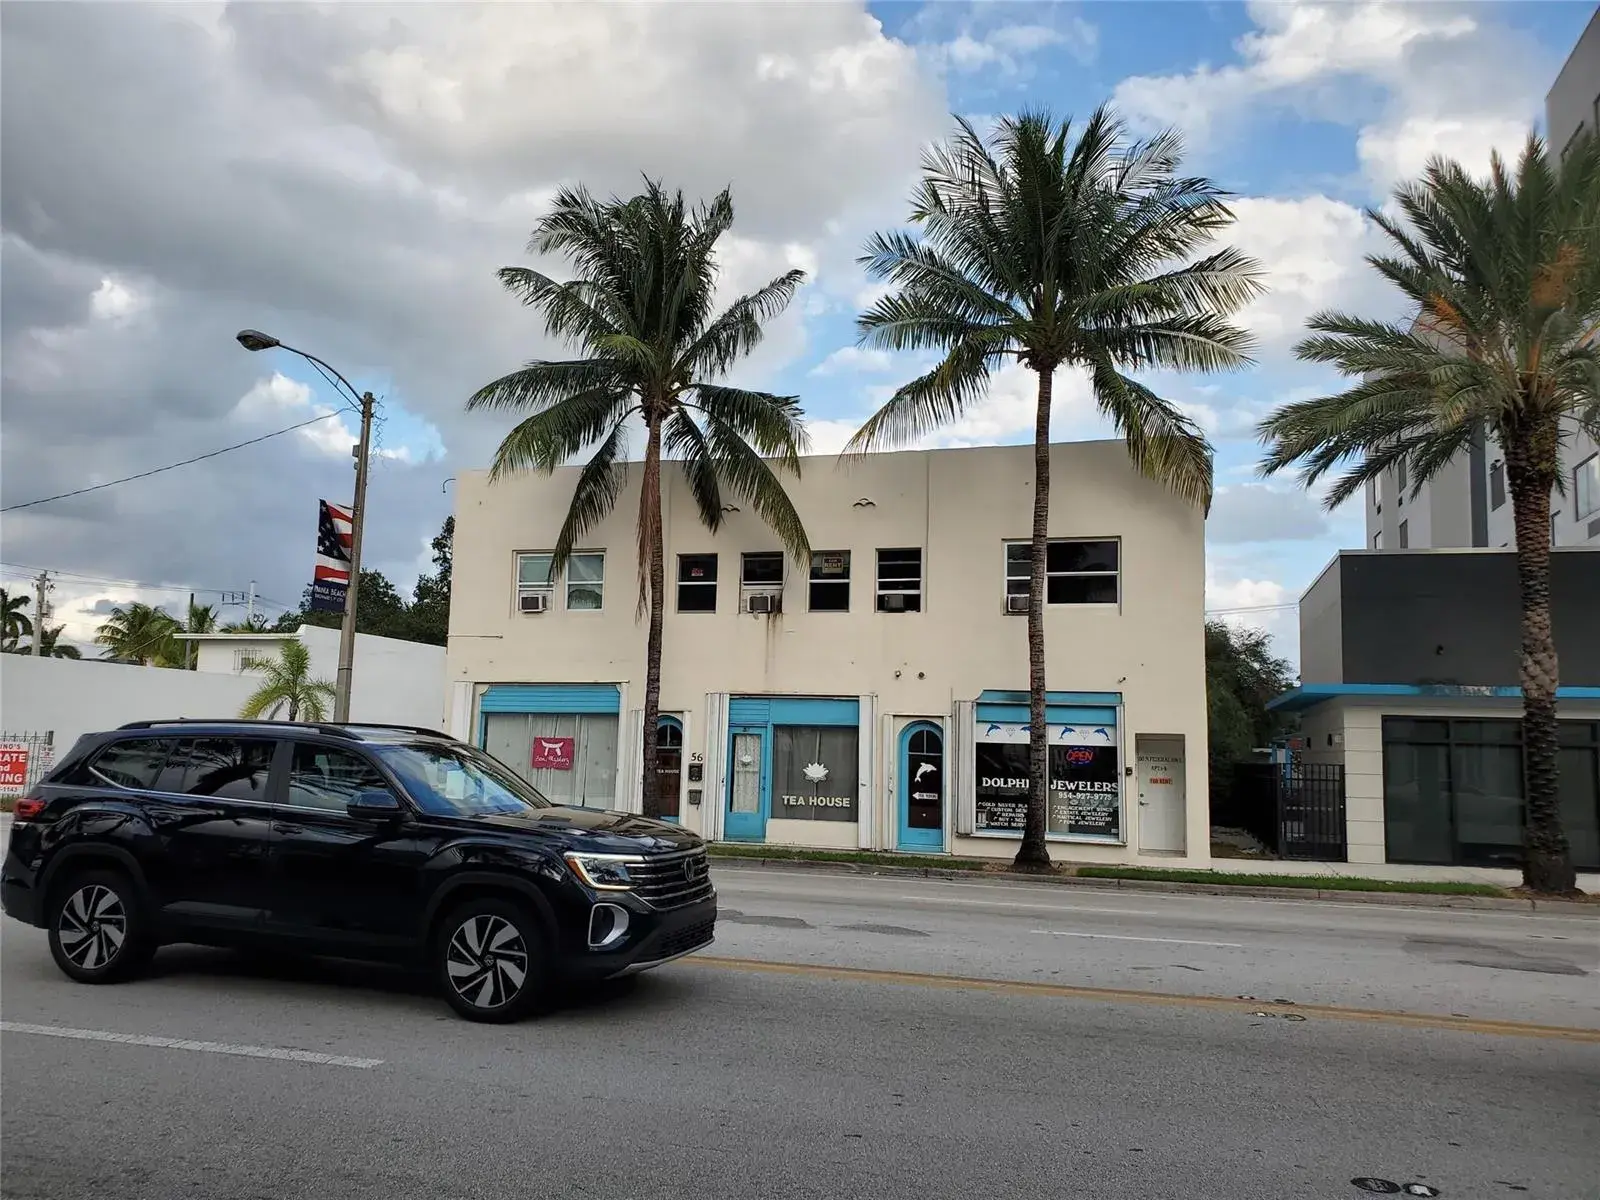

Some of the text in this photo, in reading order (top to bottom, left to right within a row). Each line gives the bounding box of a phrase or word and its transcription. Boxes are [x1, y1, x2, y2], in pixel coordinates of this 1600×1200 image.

[690, 752, 703, 762] 56
[1066, 751, 1093, 761] OPEN
[982, 777, 1118, 792] DOLPHI JEWELERS
[782, 795, 851, 807] TEA HOUSE
